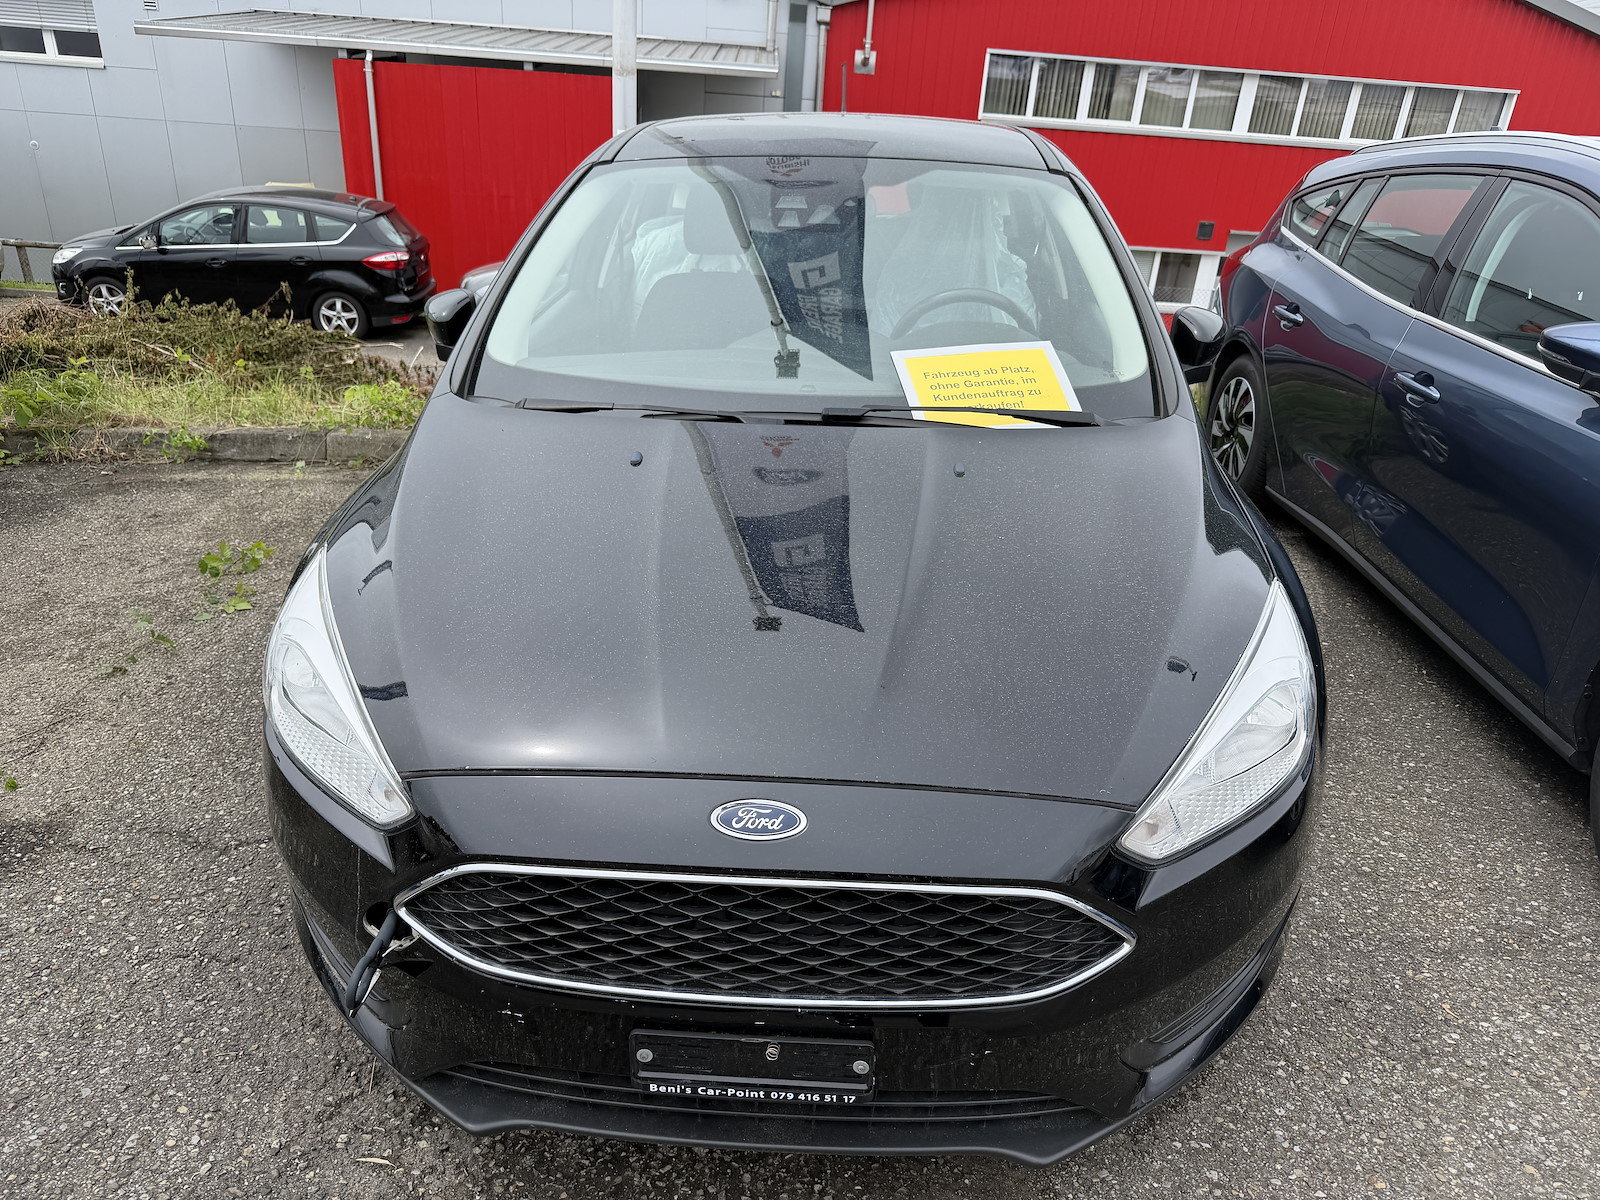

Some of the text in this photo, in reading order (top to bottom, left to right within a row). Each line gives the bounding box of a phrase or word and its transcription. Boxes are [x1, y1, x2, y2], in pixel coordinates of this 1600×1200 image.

[923, 365, 1034, 379] Fahrzeug ab Platz,
[930, 376, 1037, 390] ohne Garantie, im
[933, 388, 1025, 402] Kundenauftrag
[732, 807, 785, 829] Ford
[649, 1083, 692, 1094] Beni's
[697, 1086, 765, 1098] Car-Point
[770, 1091, 794, 1100] 079
[798, 1093, 820, 1102] 416
[843, 1095, 857, 1104] 17
